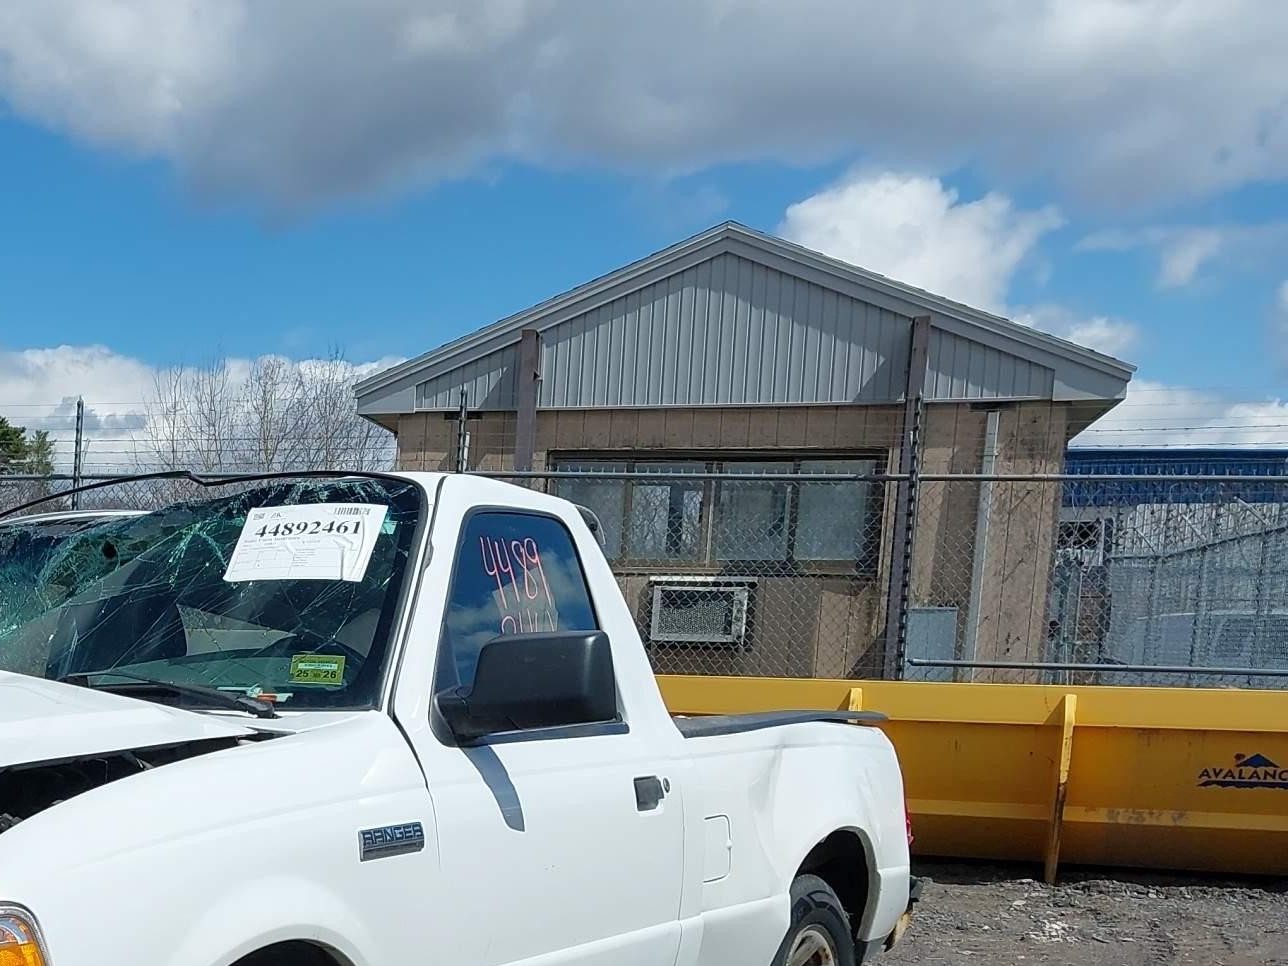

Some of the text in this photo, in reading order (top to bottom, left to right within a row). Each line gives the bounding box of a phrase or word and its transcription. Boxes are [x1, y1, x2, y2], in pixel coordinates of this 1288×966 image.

[255, 520, 361, 538] 44892461
[479, 536, 552, 609] 4489
[295, 670, 309, 678] 25
[322, 670, 337, 679] 26
[362, 823, 423, 849] RANGER
